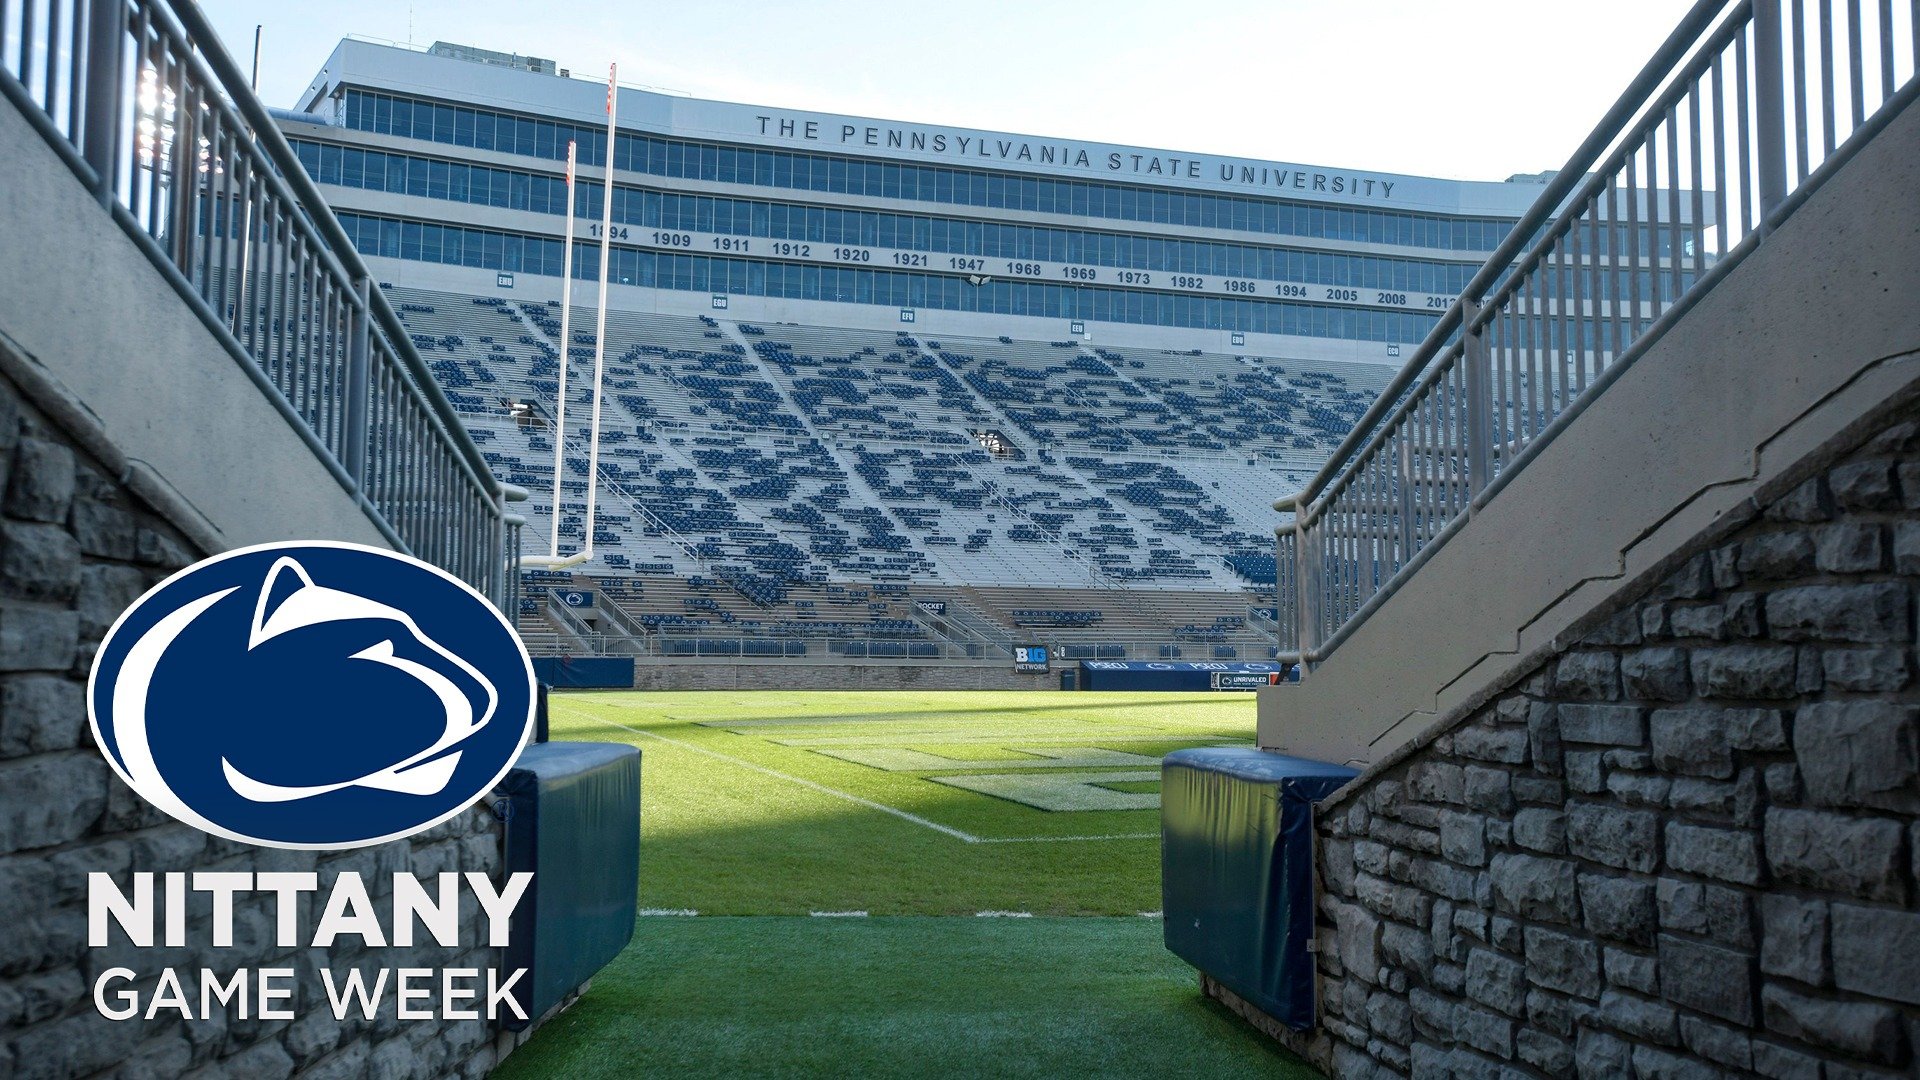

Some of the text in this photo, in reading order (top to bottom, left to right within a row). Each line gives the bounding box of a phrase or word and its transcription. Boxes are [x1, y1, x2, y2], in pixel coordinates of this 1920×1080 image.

[756, 115, 1395, 199] THE PENNSYLVANIA STATE UNIVERSITY
[652, 231, 691, 248] 1909
[712, 237, 749, 253] 1911
[772, 242, 810, 258] 1912
[833, 247, 870, 263] 1920
[892, 252, 929, 268] 1921
[949, 257, 985, 273] 1947
[1006, 261, 1042, 276] 1968
[1062, 266, 1097, 281] 1969
[1117, 270, 1151, 285] 1973
[1170, 275, 1204, 290] 1982
[1223, 279, 1256, 294] 1986
[1275, 284, 1307, 298] 1994
[1326, 288, 1358, 302] 2005
[1377, 292, 1407, 305] 2008
[902, 312, 914, 321] EFU
[1072, 324, 1083, 333] EEU
